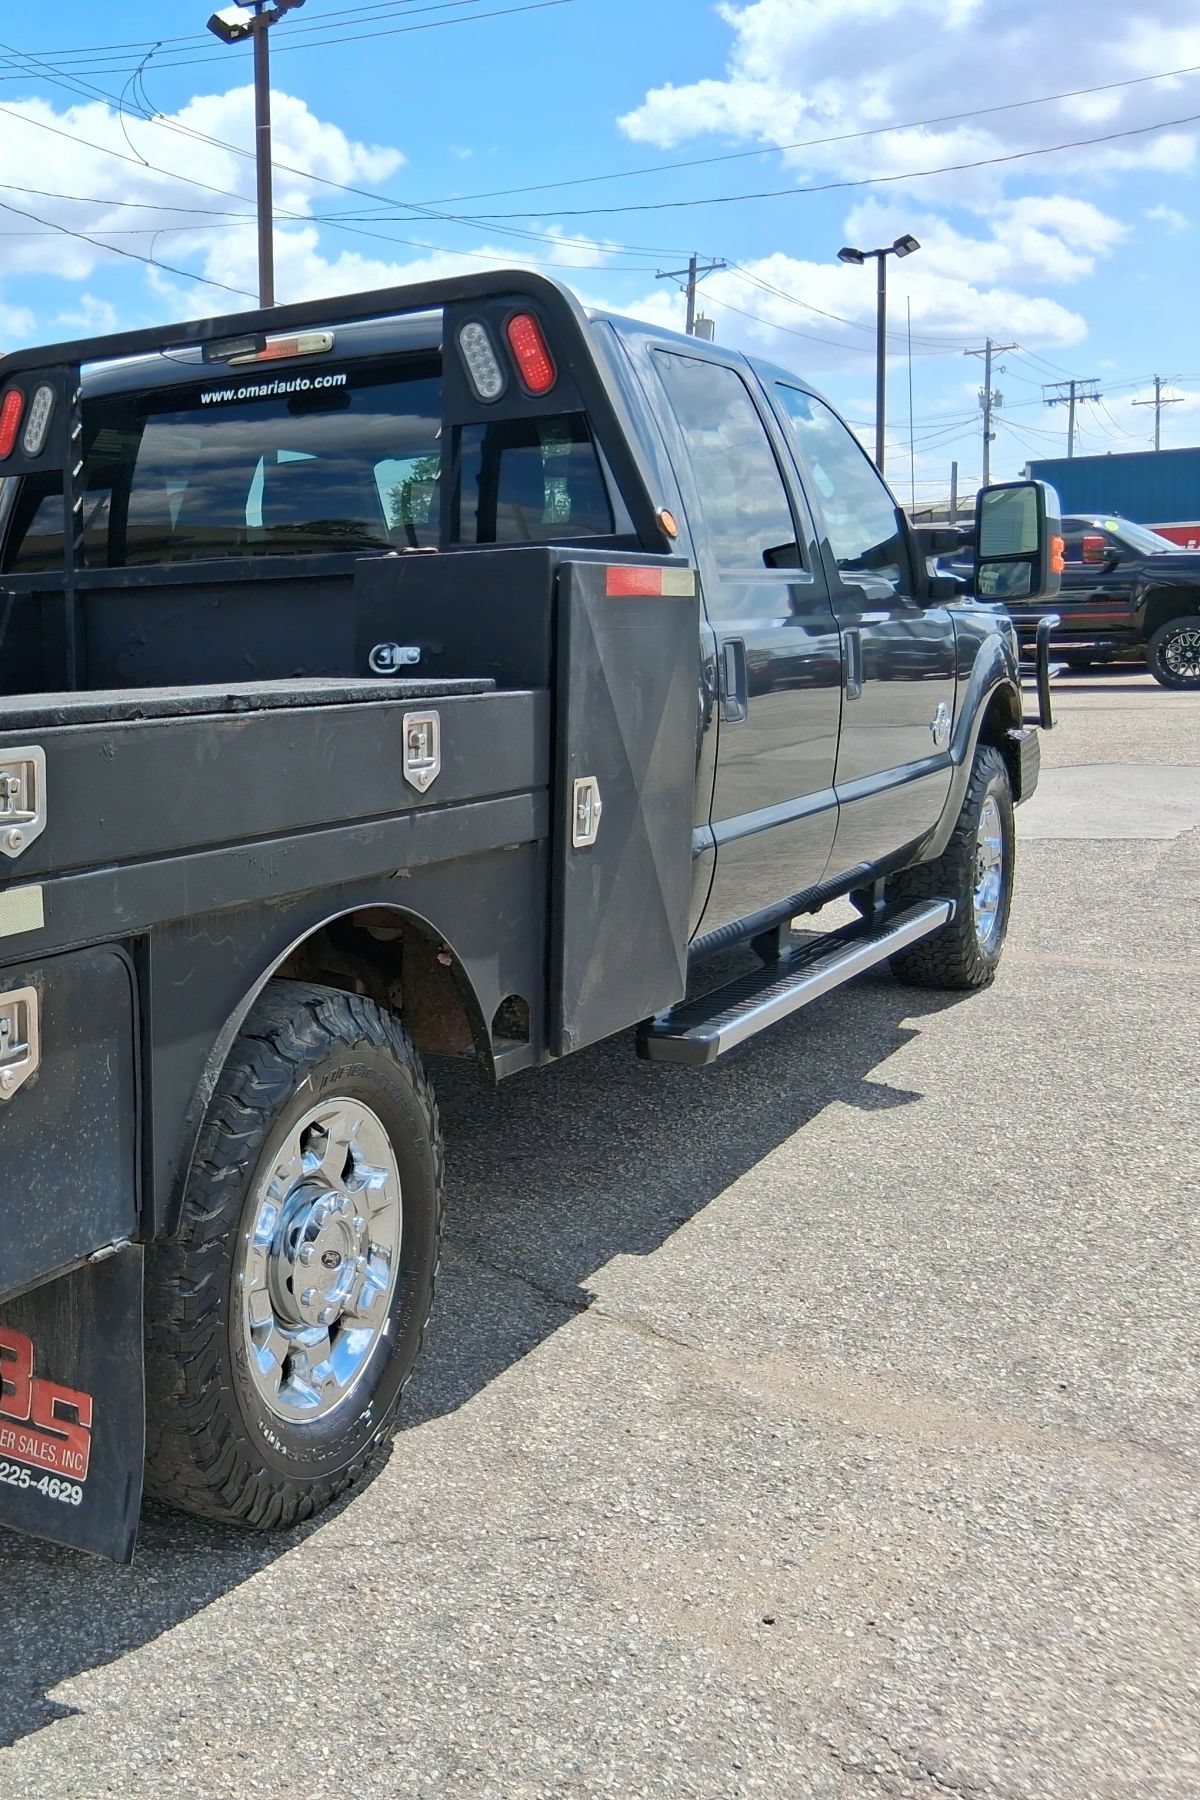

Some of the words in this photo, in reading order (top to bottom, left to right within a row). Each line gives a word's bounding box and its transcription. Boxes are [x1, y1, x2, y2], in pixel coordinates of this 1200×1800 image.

[200, 373, 347, 404] www.omariauto.com
[17, 1434, 59, 1466] SALES,
[61, 1450, 86, 1473] INC.
